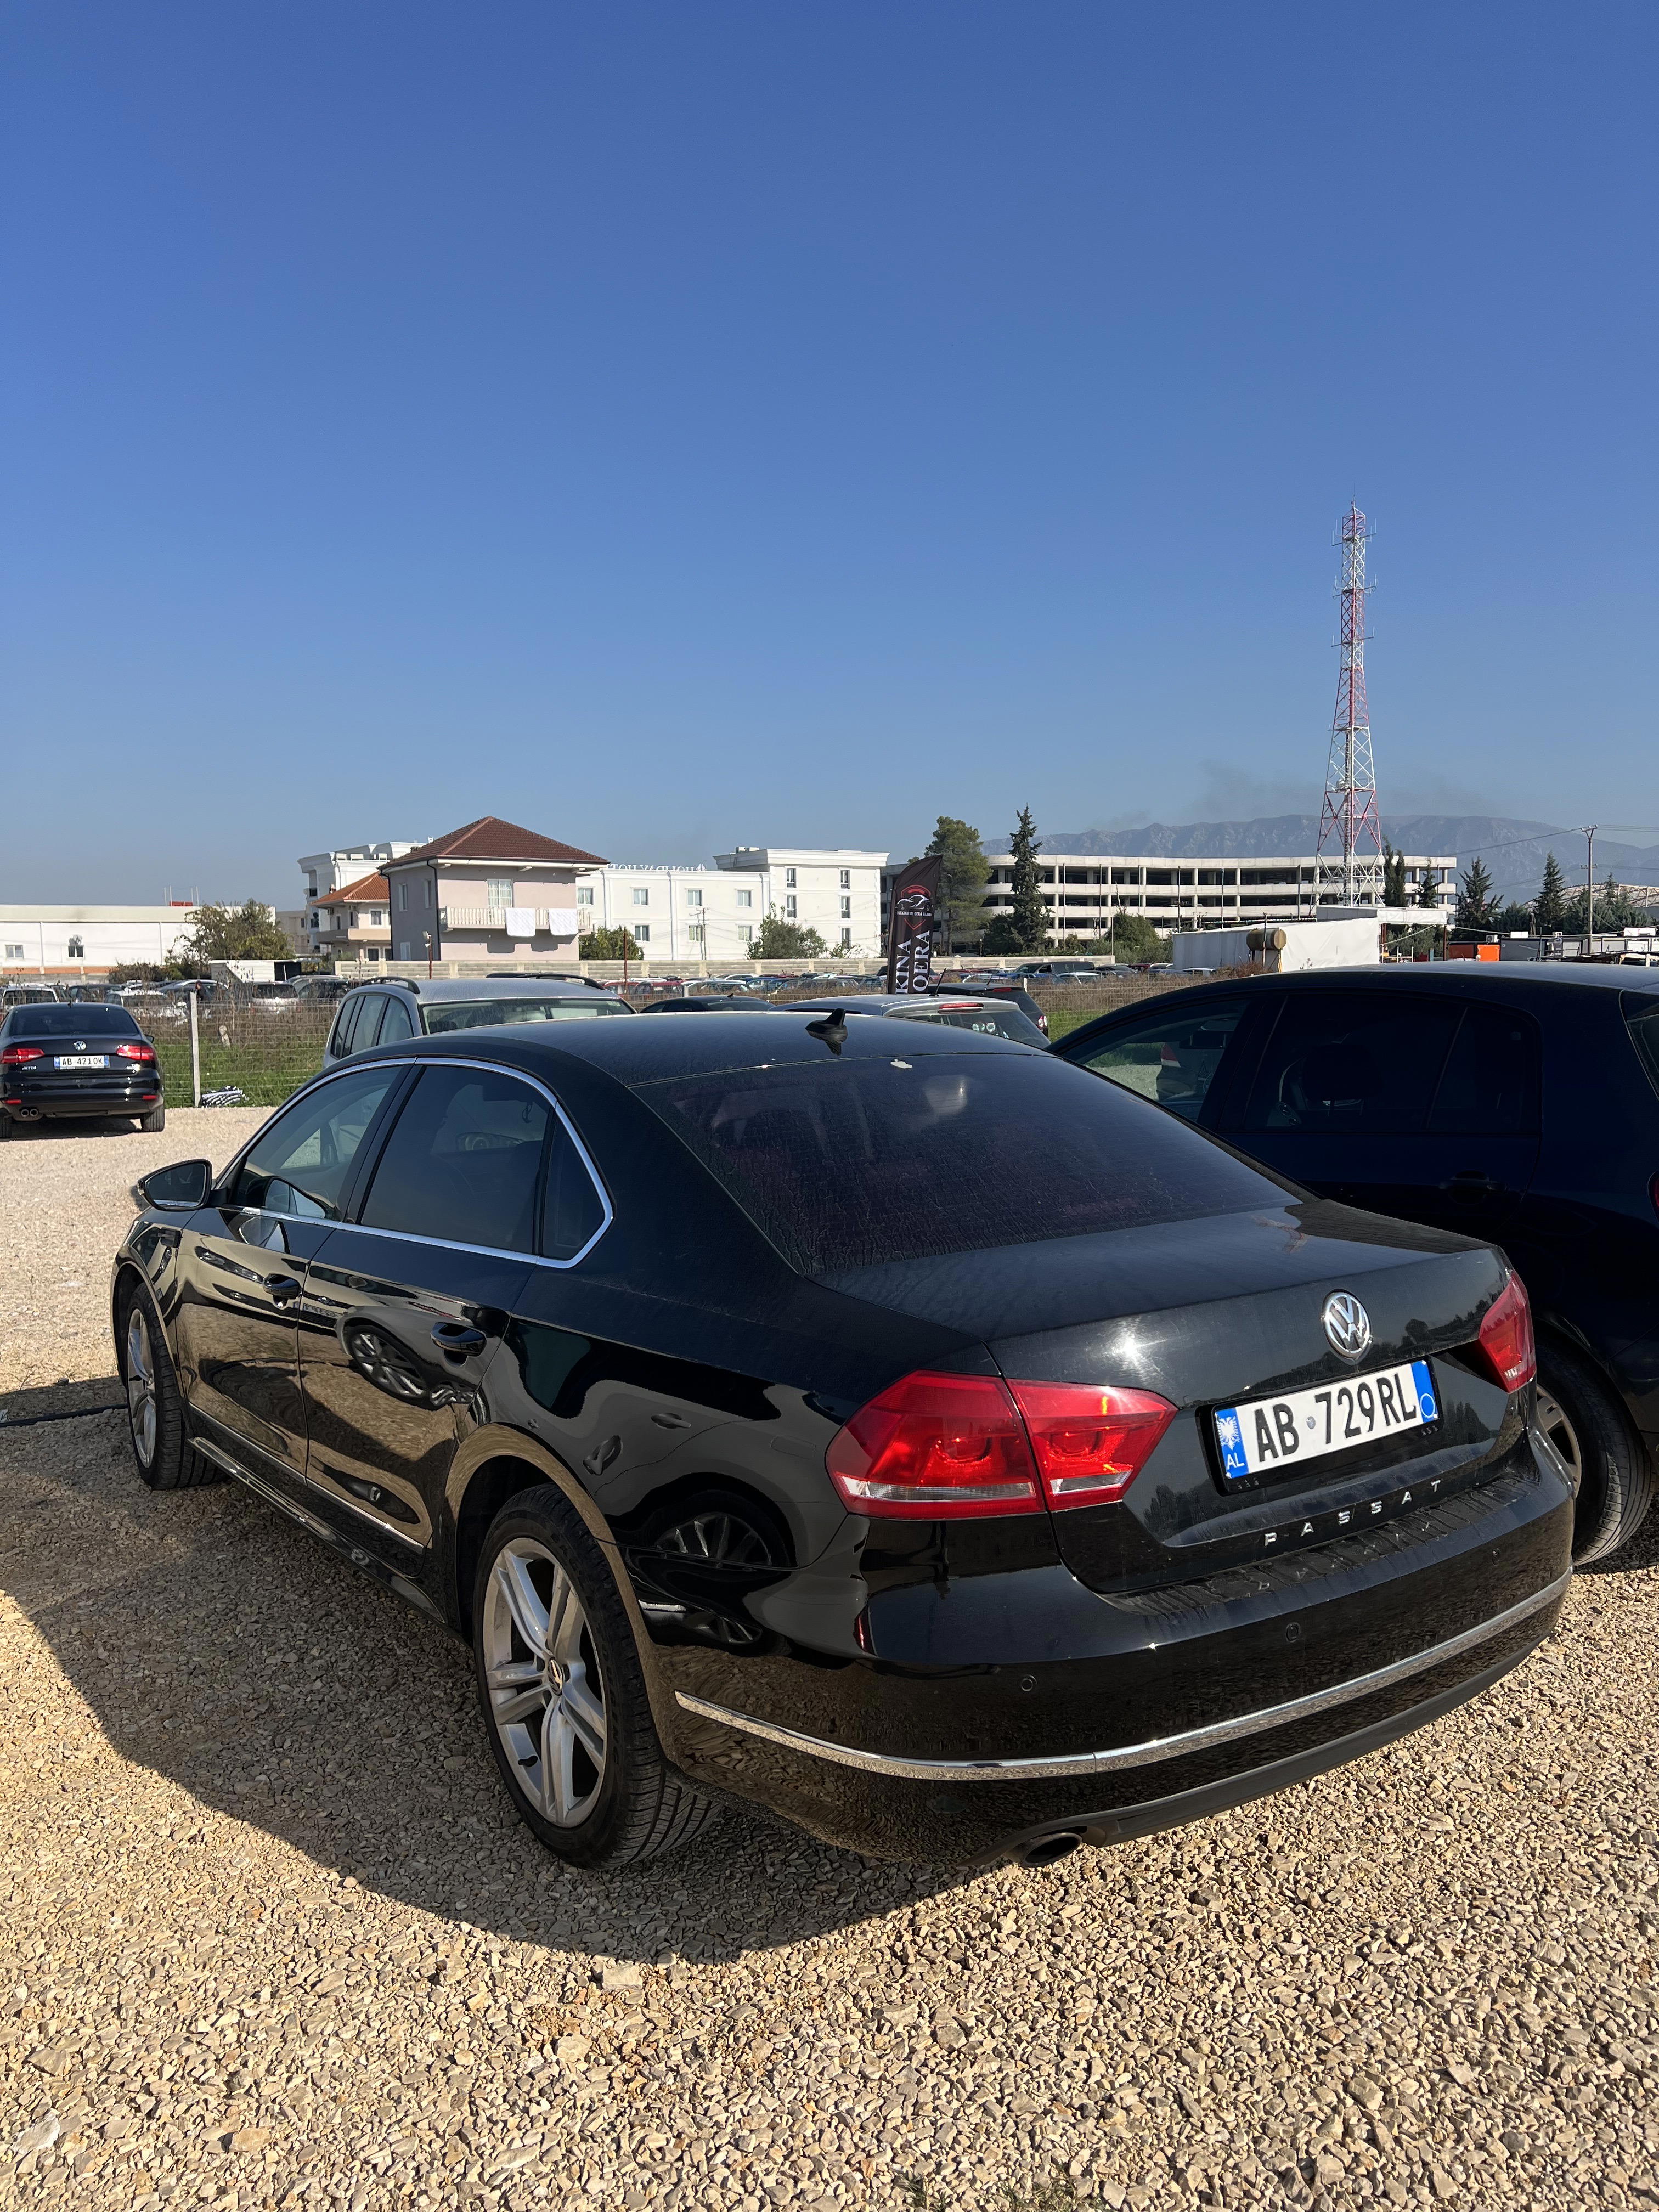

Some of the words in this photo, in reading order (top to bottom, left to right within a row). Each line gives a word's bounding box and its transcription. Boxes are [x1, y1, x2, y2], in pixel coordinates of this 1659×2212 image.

[913, 929, 930, 991] QERA
[1254, 1403, 1300, 1463] AB
[1314, 1373, 1417, 1444] 729RL
[1226, 1453, 1245, 1470] AL
[1264, 1479, 1441, 1547] PASSAT
